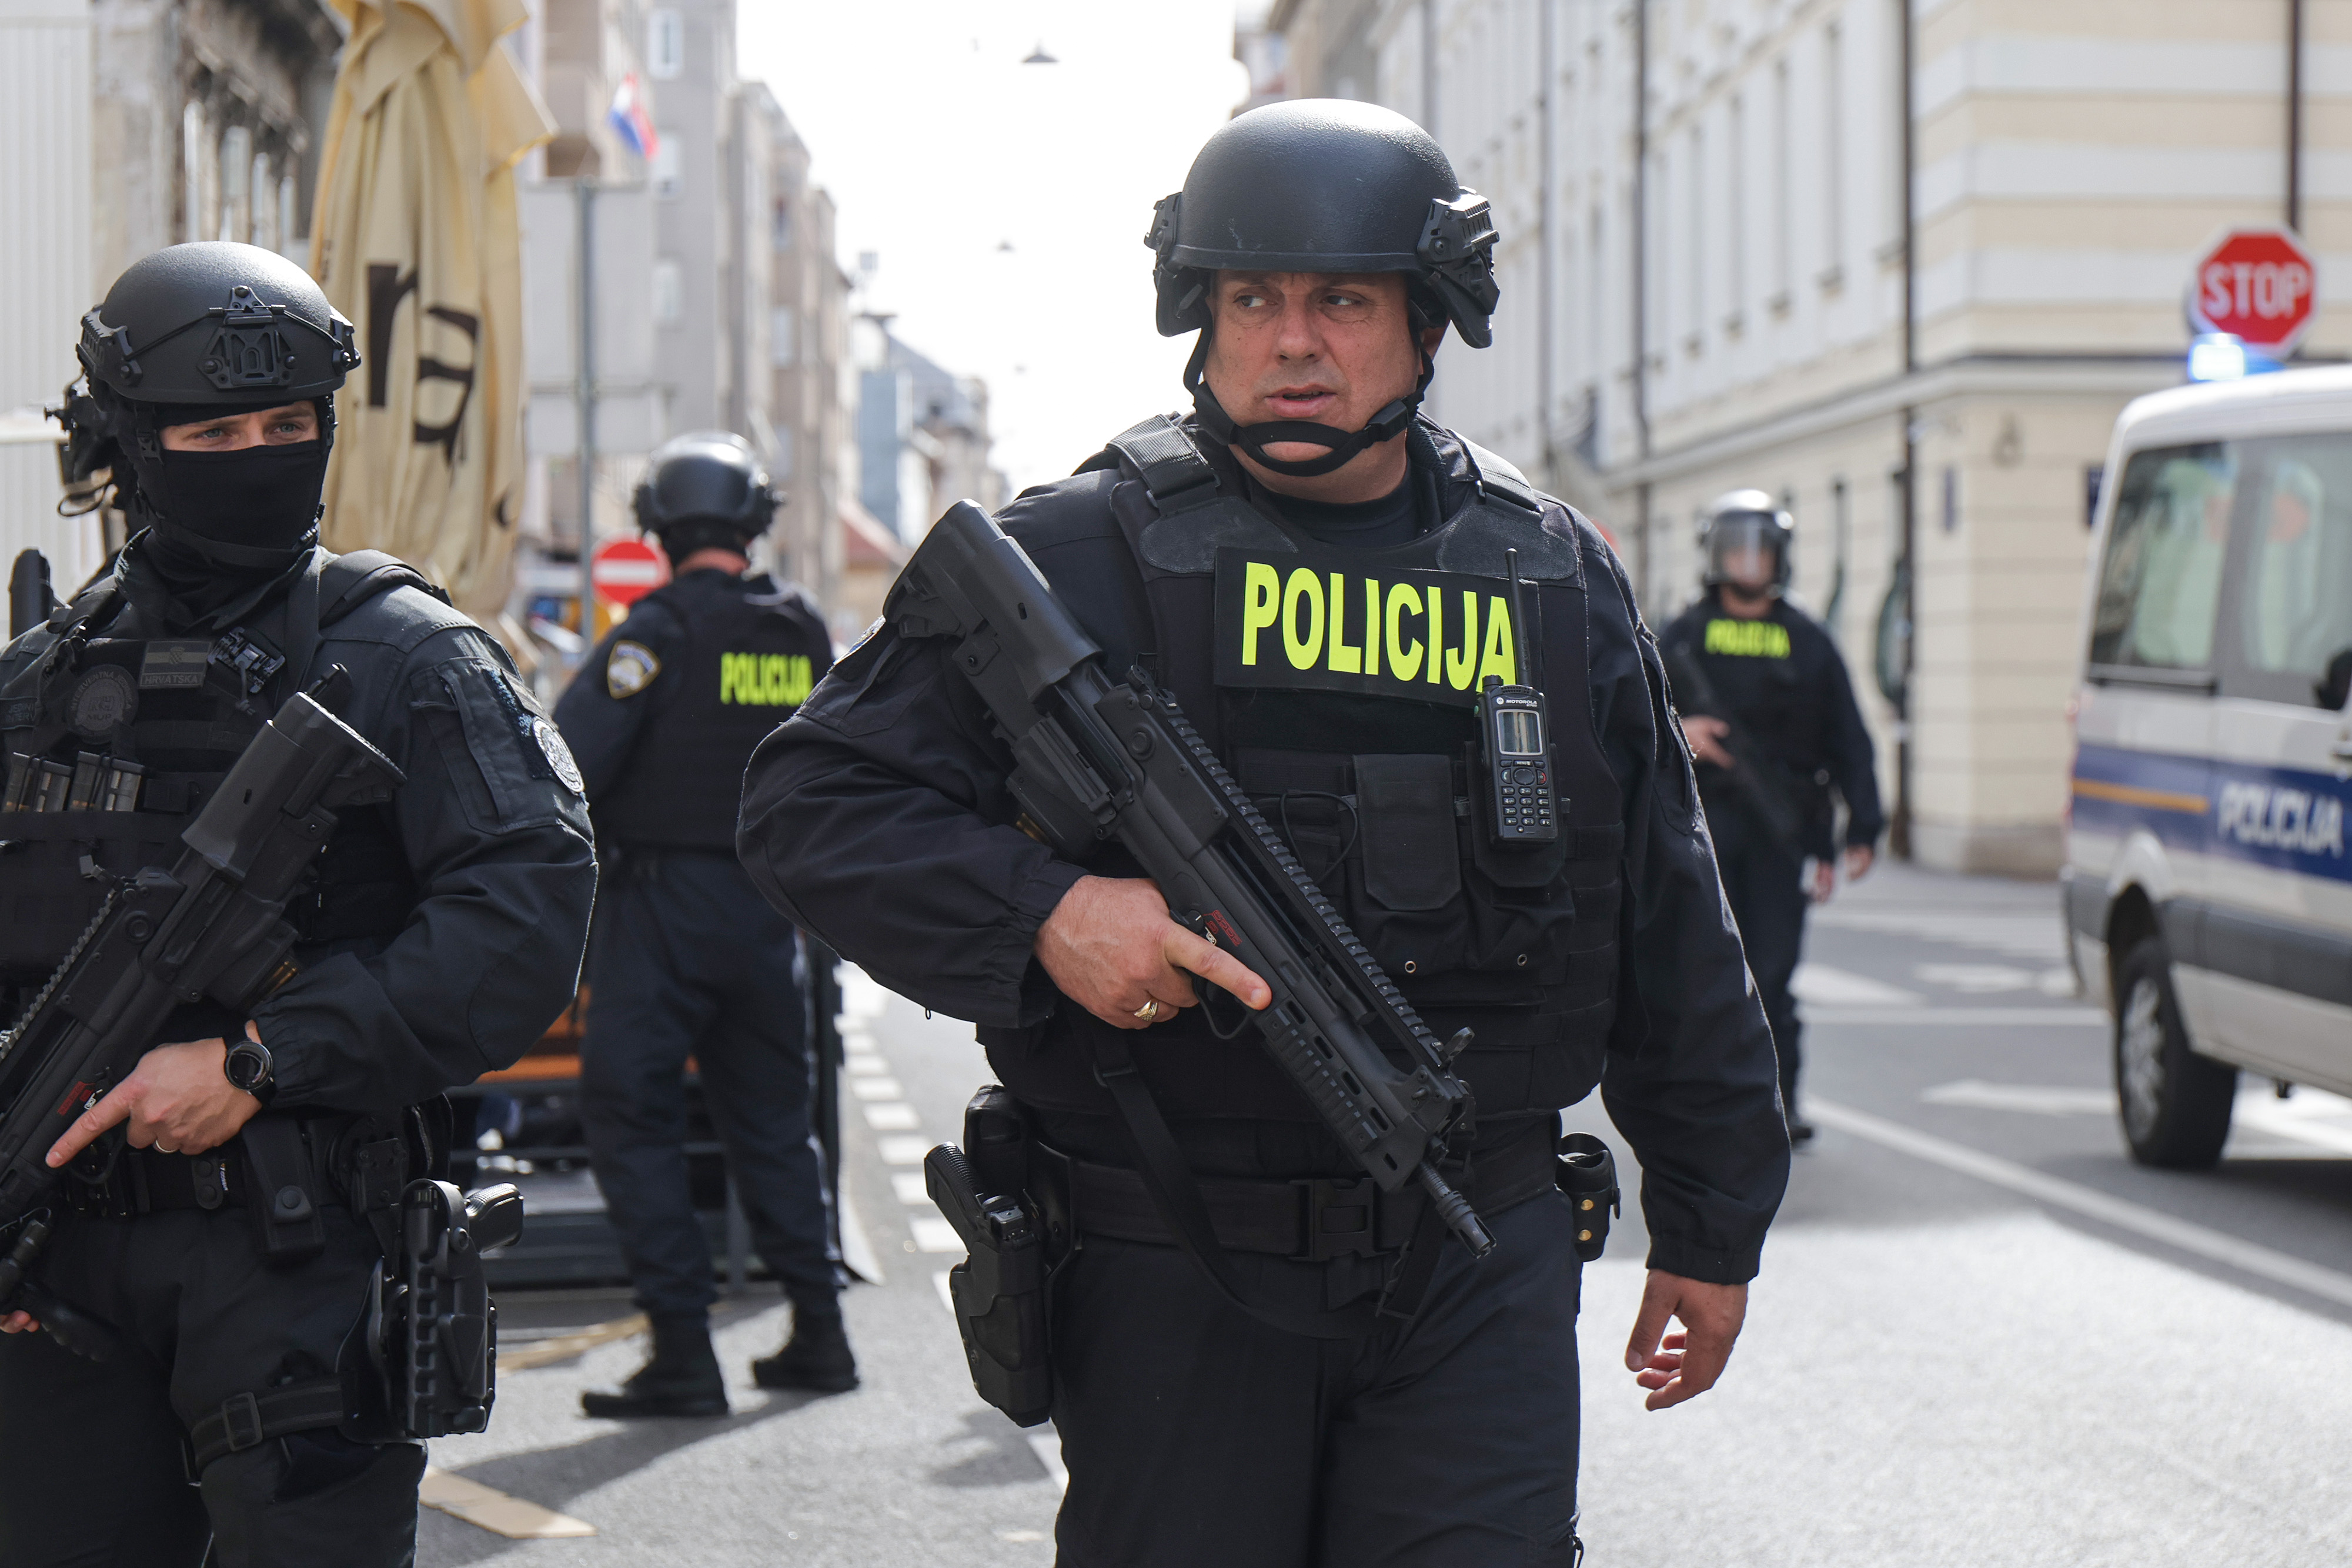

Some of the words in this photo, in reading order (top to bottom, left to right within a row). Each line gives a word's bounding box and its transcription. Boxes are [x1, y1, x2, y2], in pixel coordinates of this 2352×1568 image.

[2204, 262, 2310, 319] STOP
[1242, 562, 1516, 692] POLICIJA
[144, 675, 198, 684] HRVATSKA
[721, 653, 813, 706] POLICIJA
[87, 713, 112, 721] MUP
[2217, 781, 2344, 858] POLICIJA
